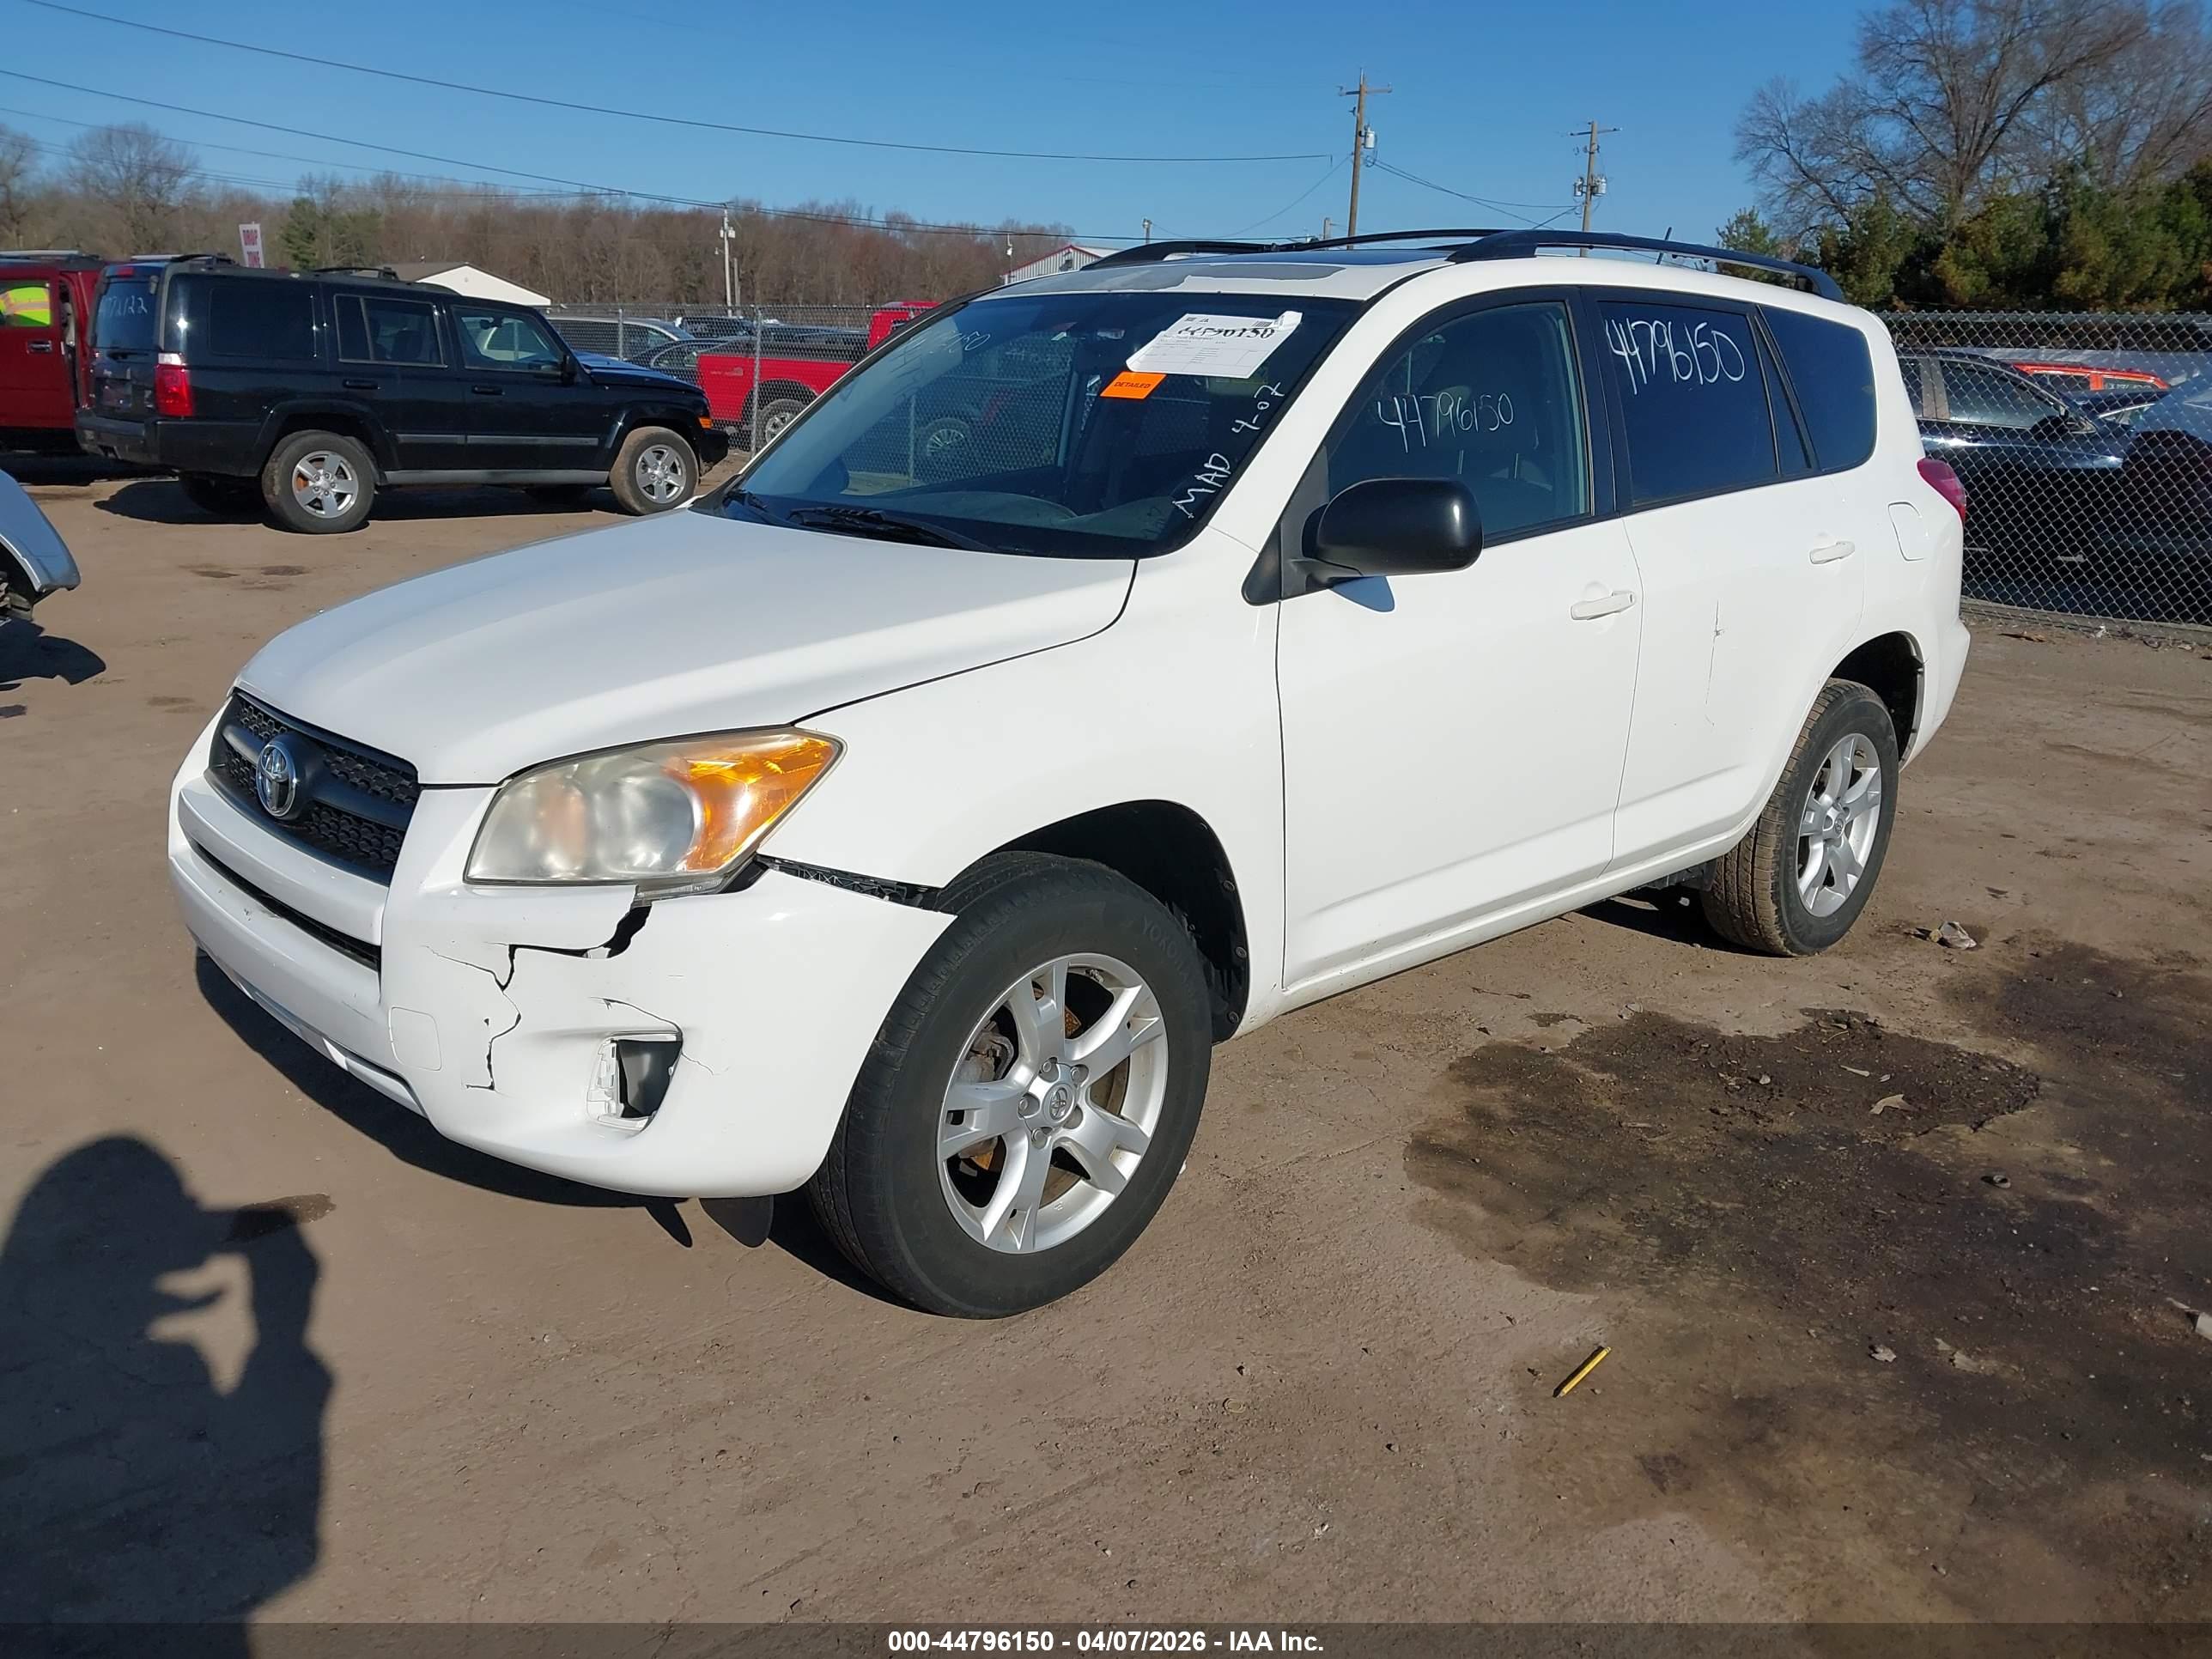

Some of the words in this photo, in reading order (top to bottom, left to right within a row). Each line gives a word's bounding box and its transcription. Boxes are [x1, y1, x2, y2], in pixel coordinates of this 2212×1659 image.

[1605, 318, 1745, 395] 44796150
[1172, 453, 1231, 519] MAD
[1231, 382, 1285, 434] 4-07
[1377, 392, 1514, 453] 44796150
